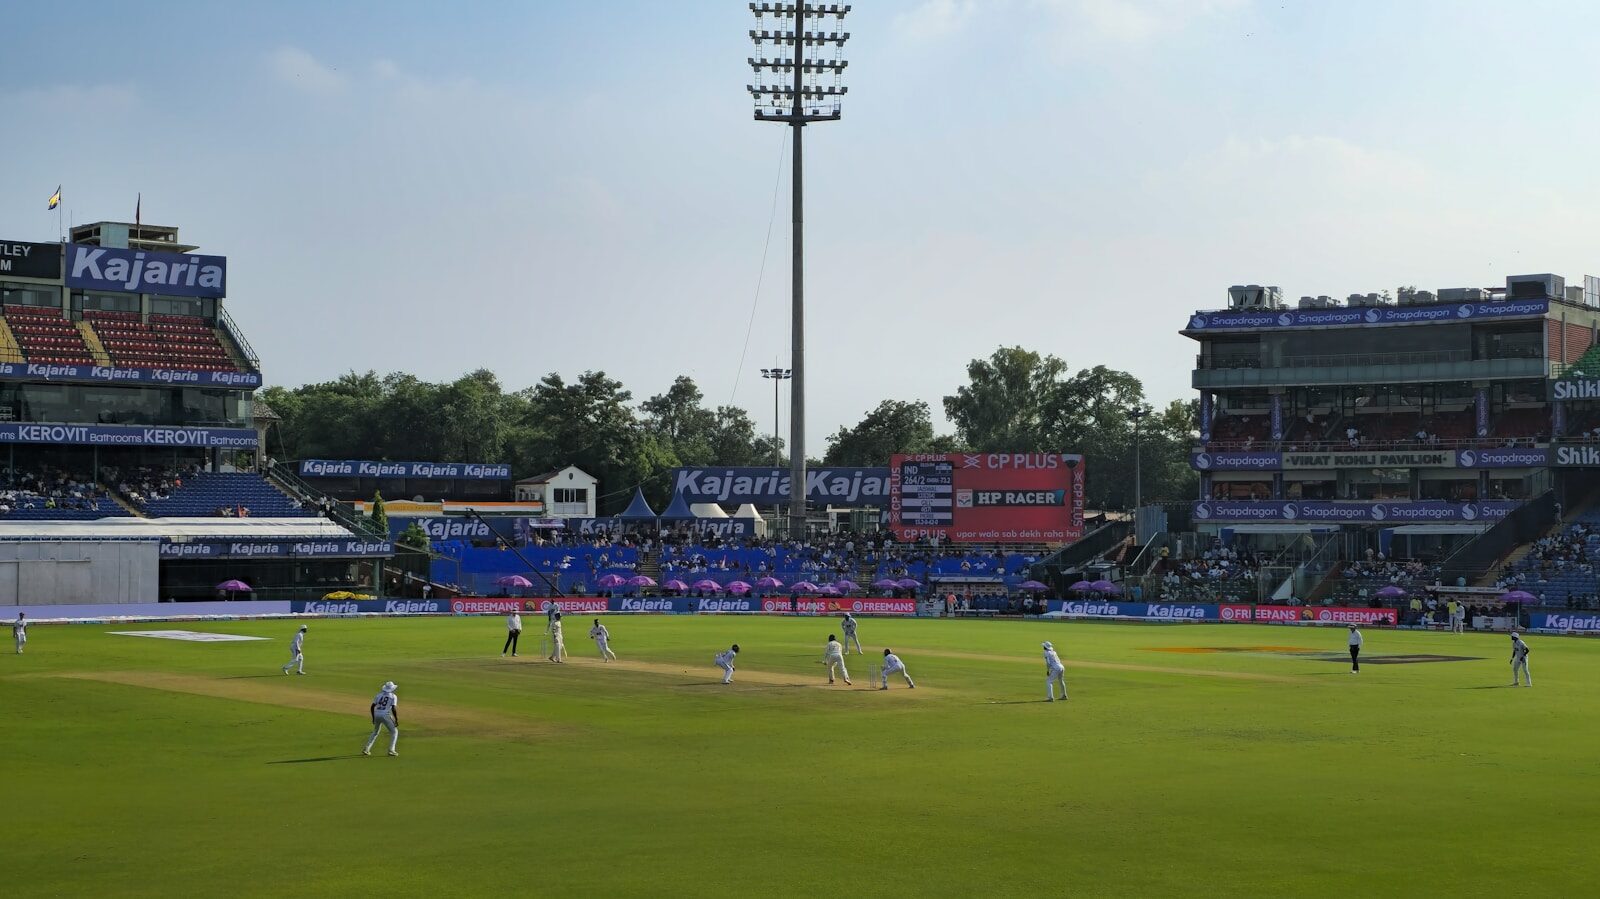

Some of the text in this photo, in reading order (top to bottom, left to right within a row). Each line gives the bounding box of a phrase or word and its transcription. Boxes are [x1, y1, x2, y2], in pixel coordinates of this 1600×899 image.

[71, 247, 222, 290] Kajaria
[1385, 309, 1450, 321] Snapdragon
[1479, 302, 1544, 315] Snapdragon
[1211, 316, 1273, 327] Snapdragon
[1298, 313, 1361, 325] Snapdragon
[27, 364, 77, 378] Kajaria
[91, 366, 140, 380] Kajaria
[151, 369, 199, 383] Kajaria
[211, 371, 257, 385] Kajaria
[18, 426, 88, 441] KEROVIT
[90, 433, 142, 443] Bathrooms
[143, 429, 209, 445] KEROVIT
[210, 436, 258, 446] Bathrooms
[987, 453, 1058, 469] CP PLUS
[1216, 456, 1278, 467] Snapdragon
[1290, 454, 1442, 466] VIRAT KOHLI PAVILION
[1481, 452, 1546, 465] Snapdragon
[303, 461, 508, 479] Kajaria Kajaria Kajaria Kajaria
[904, 465, 918, 475] IND
[676, 470, 790, 501] Kajaria
[892, 467, 900, 511] CP PLUS
[978, 492, 1055, 504] HP RACER
[1073, 483, 1083, 527] CP PLUS
[1216, 506, 1278, 518] Snapdragon
[1303, 507, 1366, 519] Snapdragon
[1392, 507, 1455, 519] Snapdragon
[417, 518, 490, 540] Kajaria
[904, 529, 918, 539] CP
[1019, 529, 1041, 538] dekh
[160, 543, 211, 557] Kajaria
[230, 542, 279, 556] Kajaria
[293, 541, 391, 555] Kajaria Kajaria
[304, 600, 438, 613] Kajaria Kajaria
[464, 602, 520, 612] FREEMANS
[556, 601, 608, 611] REEMANS
[621, 598, 750, 611] Kajaria Kajaria
[775, 601, 826, 611] FREMANS
[863, 602, 914, 611] FREEMANS
[1061, 601, 1205, 618] Kajaria Kajaria
[1332, 611, 1395, 623] FREEMANS
[1545, 614, 1600, 630] Kajaria
